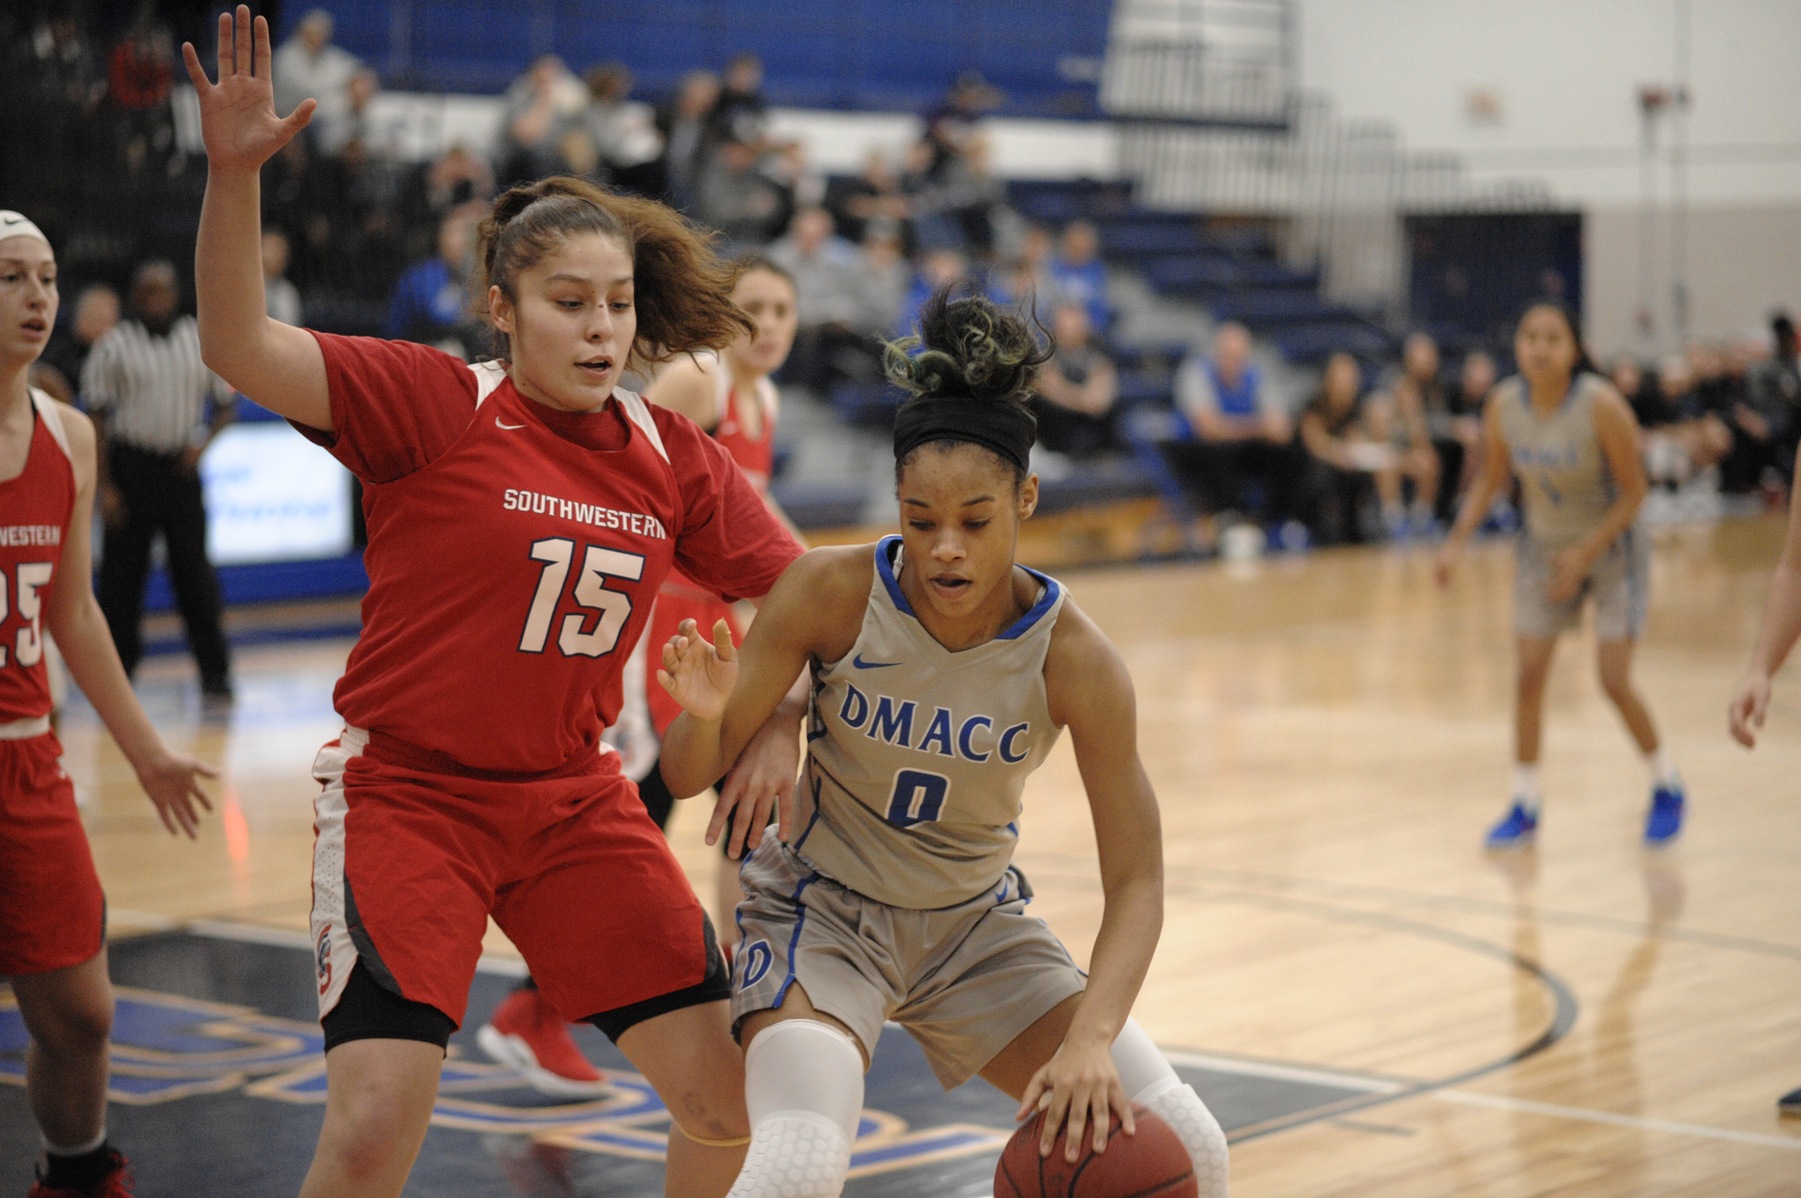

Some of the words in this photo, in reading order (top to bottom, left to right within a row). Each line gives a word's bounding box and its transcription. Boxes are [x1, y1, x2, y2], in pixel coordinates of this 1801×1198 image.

[503, 488, 667, 540] SOUTHWESTERN
[0, 562, 53, 668] 5
[516, 535, 647, 659] 15
[838, 680, 1031, 763] DMACC
[884, 767, 951, 829] 0
[738, 938, 775, 994] D
